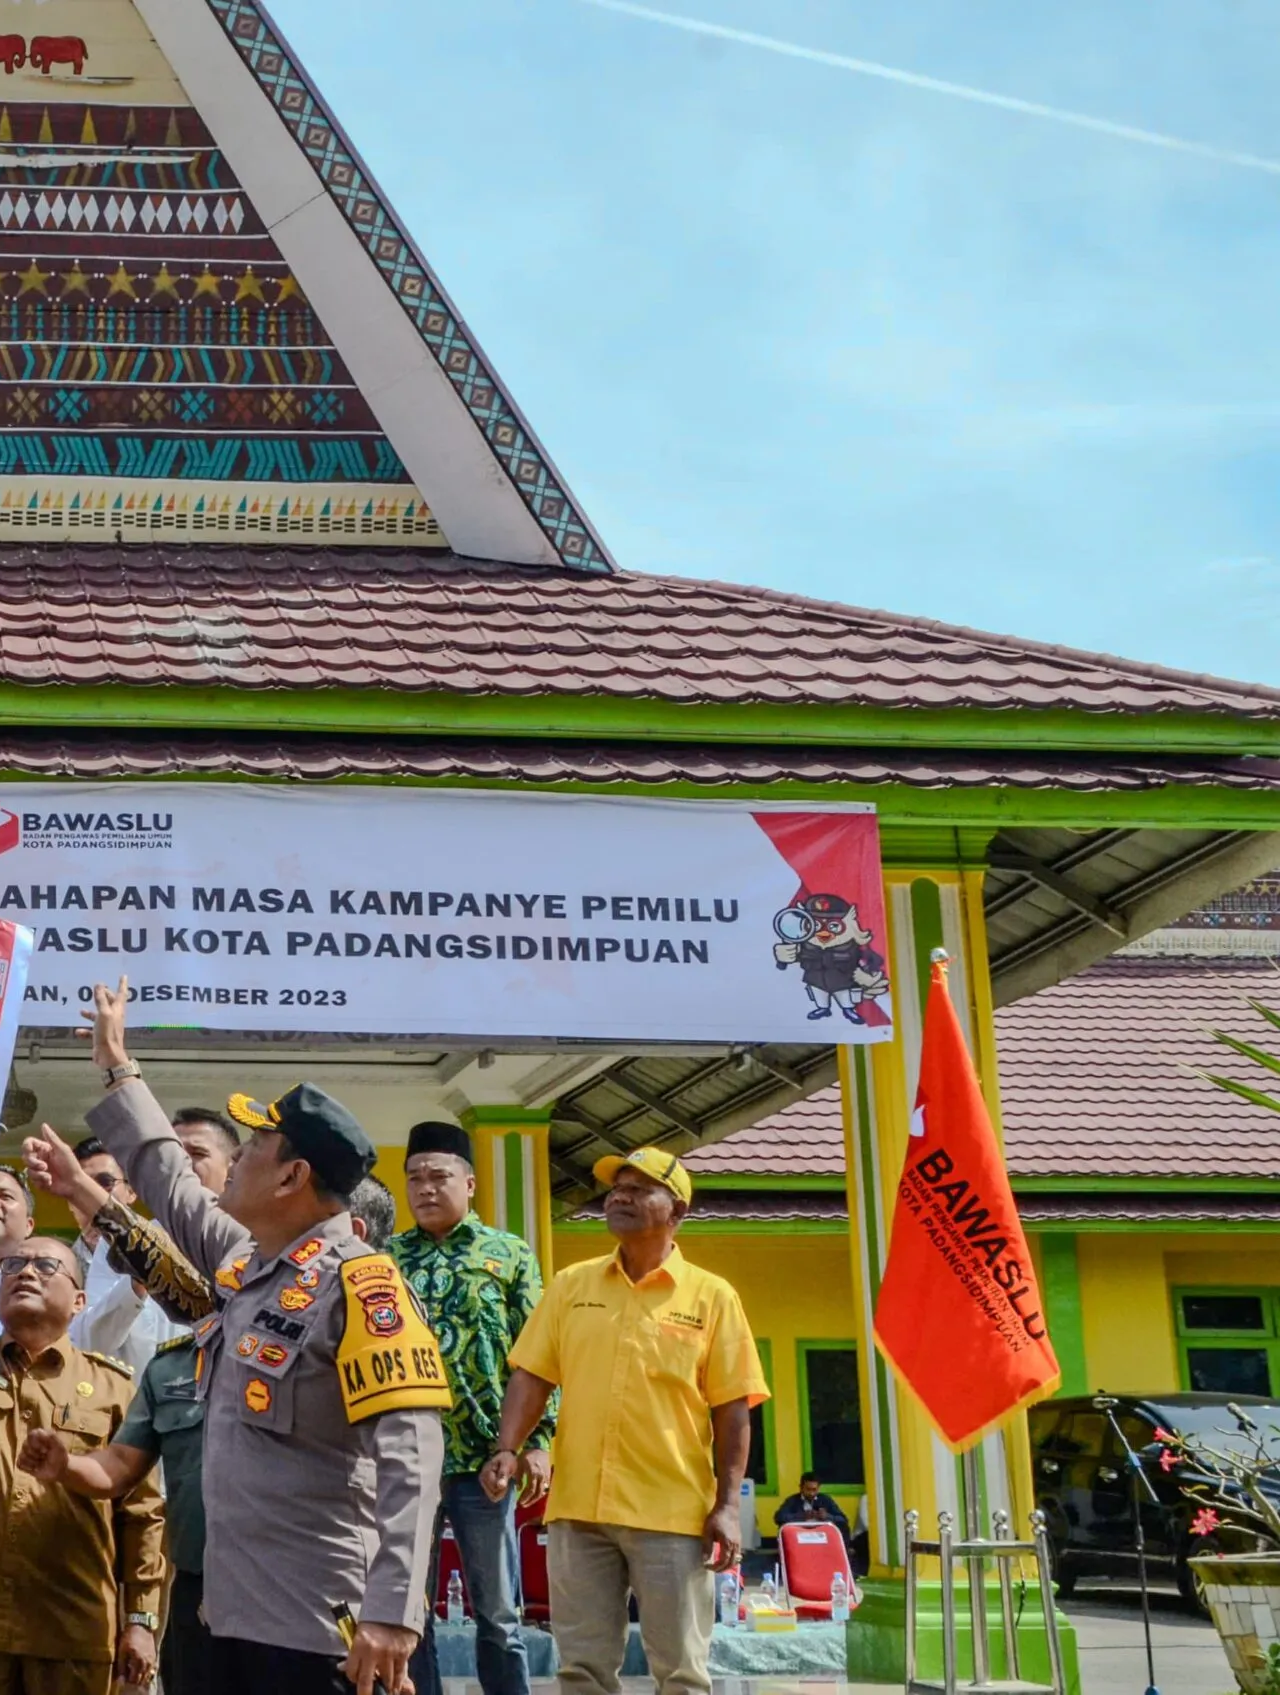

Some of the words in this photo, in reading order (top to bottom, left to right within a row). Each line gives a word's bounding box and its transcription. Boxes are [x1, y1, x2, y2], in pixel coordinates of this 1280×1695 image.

[23, 813, 172, 831] BAWASLU
[23, 840, 53, 849] KOTA
[57, 840, 173, 850] PADANGSIDIMPUAN
[192, 886, 315, 914] MASA
[329, 889, 567, 919] KAMPANYE
[581, 895, 739, 923] PEMILU
[164, 927, 272, 956] KOTA
[286, 931, 710, 964] PADANGSIDIMPUAN
[125, 984, 269, 1006] DESEMBER
[278, 989, 348, 1007] 2023
[906, 1169, 935, 1205] BADAN
[929, 1202, 973, 1258] PENGAWAS
[915, 1148, 1046, 1341] BAWASLU
[899, 1179, 923, 1217] KOTA
[919, 1216, 1023, 1353] PADANGSIDIMPUAN
[253, 1308, 306, 1341] POLRI
[342, 1357, 367, 1396] KA
[371, 1347, 407, 1386] OPS
[412, 1346, 440, 1381] RES
